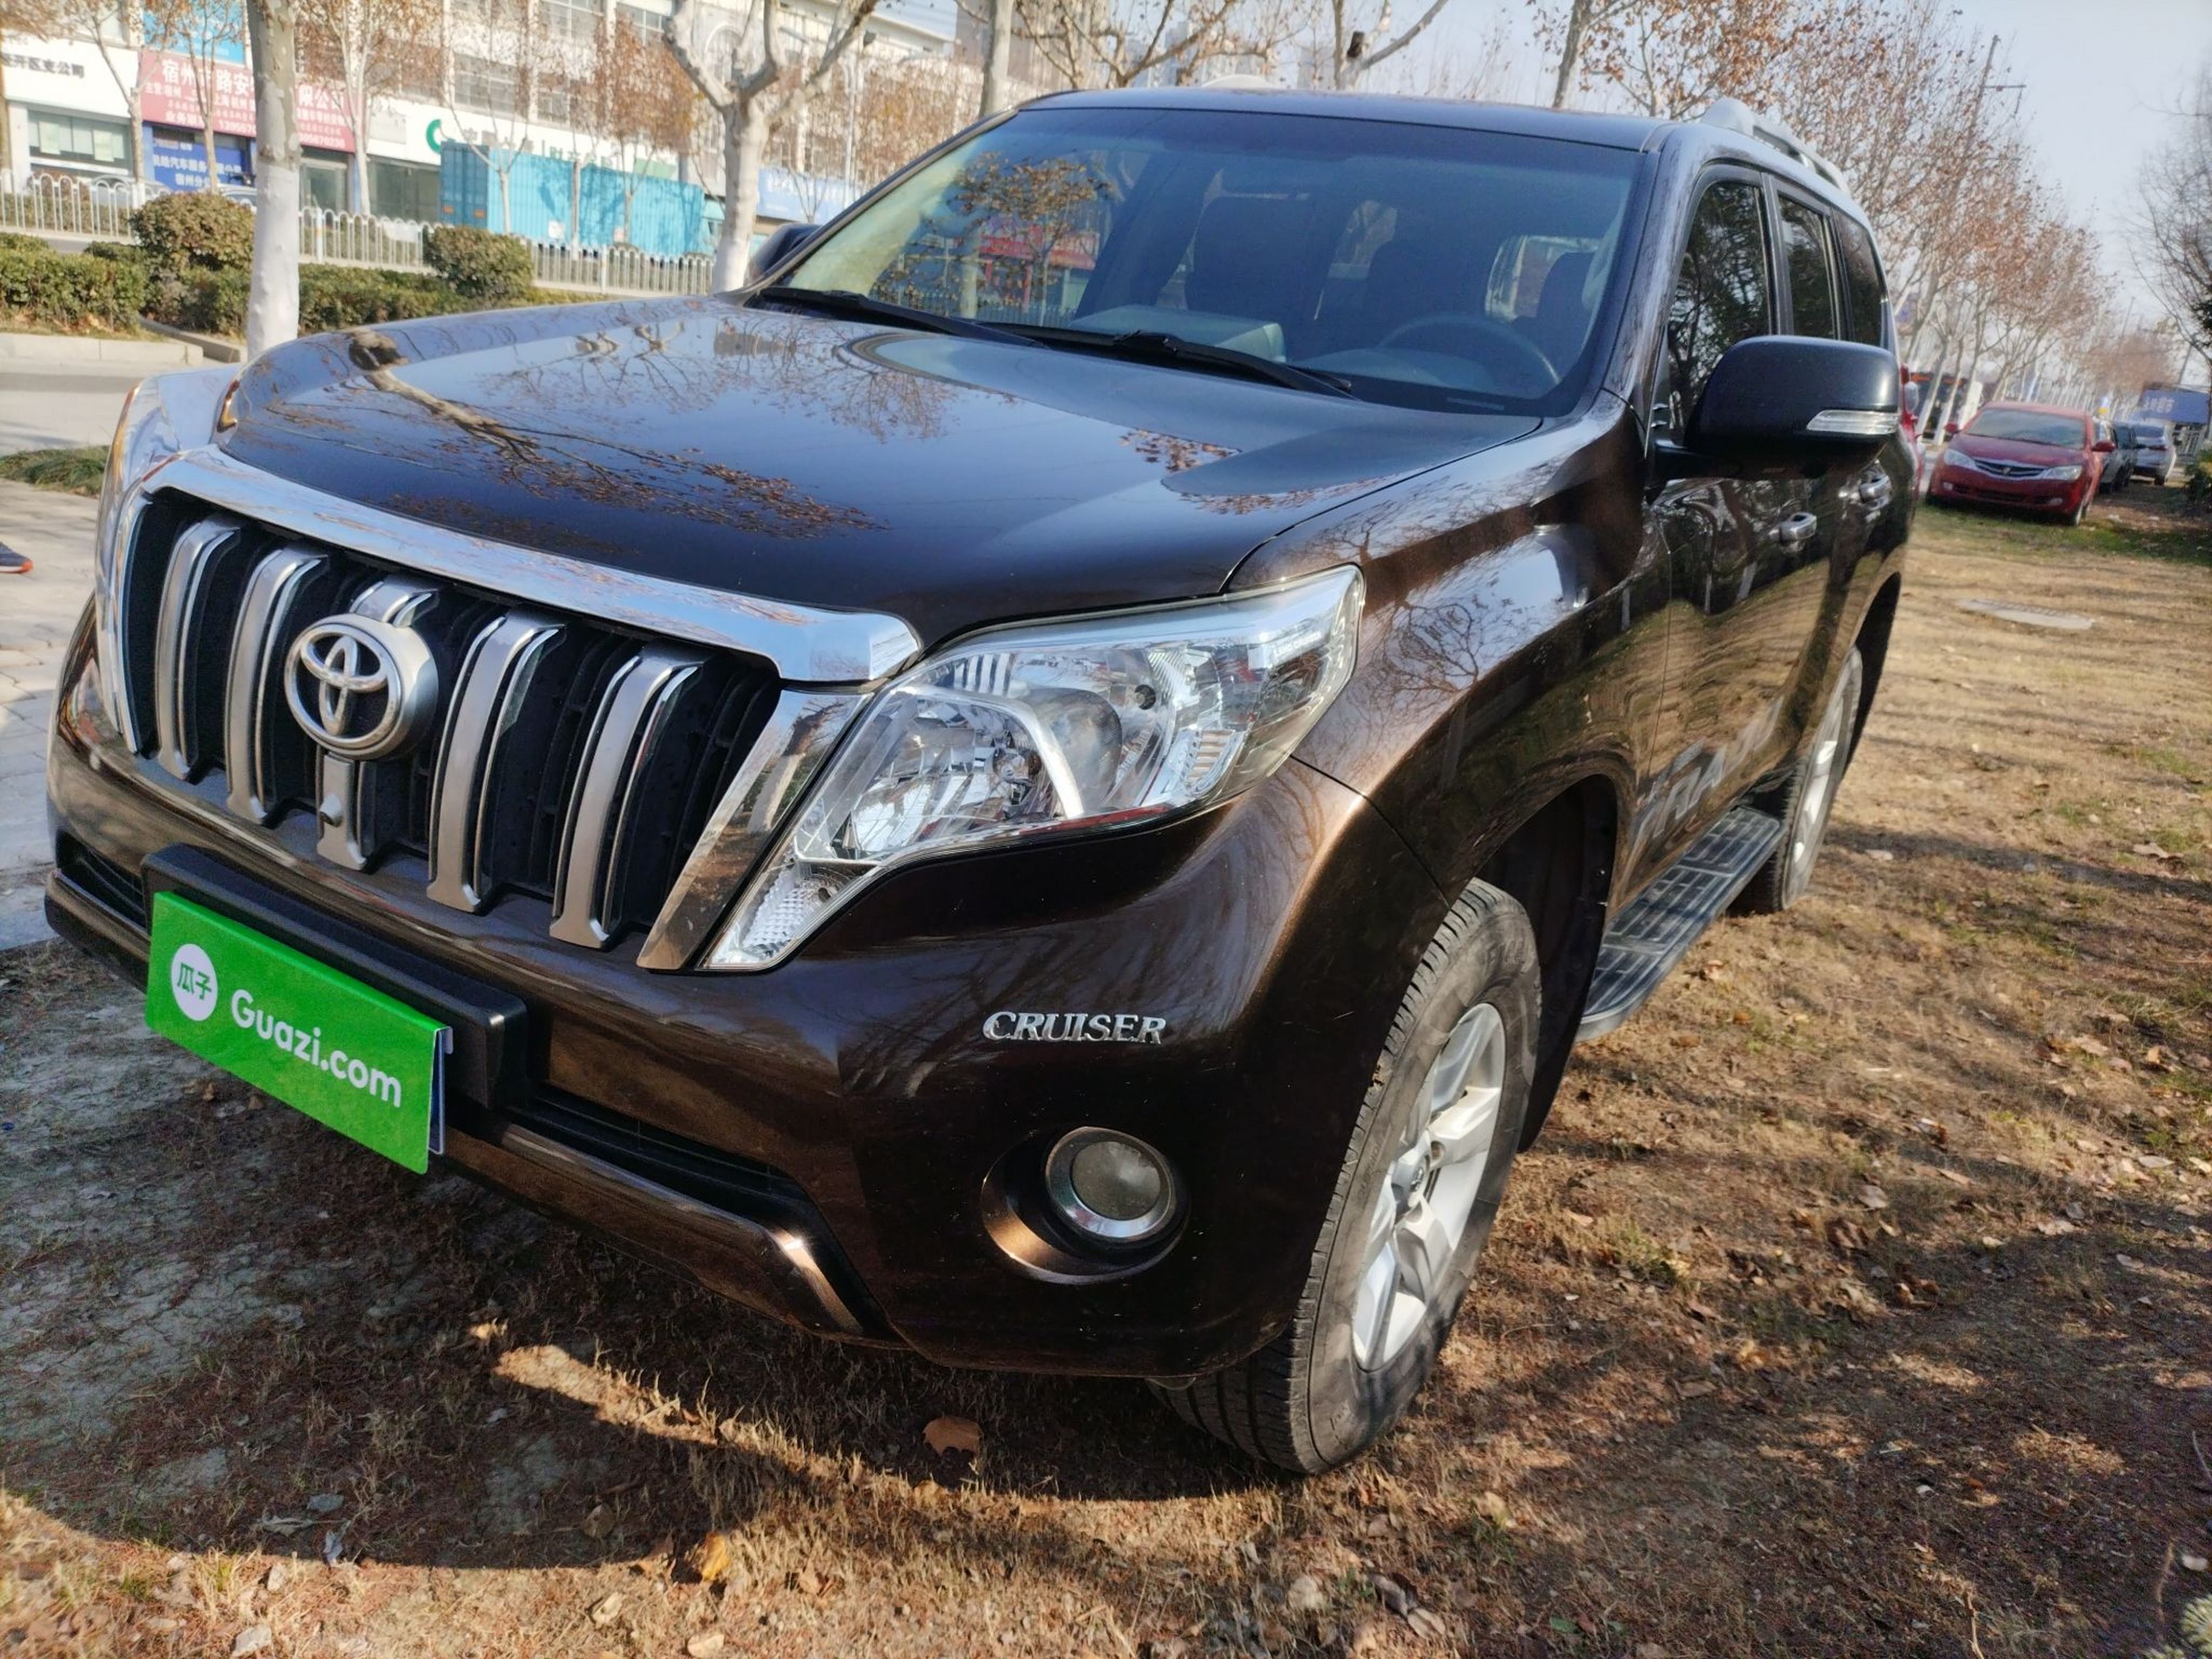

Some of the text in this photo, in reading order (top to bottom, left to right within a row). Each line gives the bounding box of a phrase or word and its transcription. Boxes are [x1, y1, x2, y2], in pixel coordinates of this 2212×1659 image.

[176, 962, 213, 1001] 瓜子
[982, 1010, 1166, 1045] CRUISER
[231, 988, 402, 1108] Guazi.com
